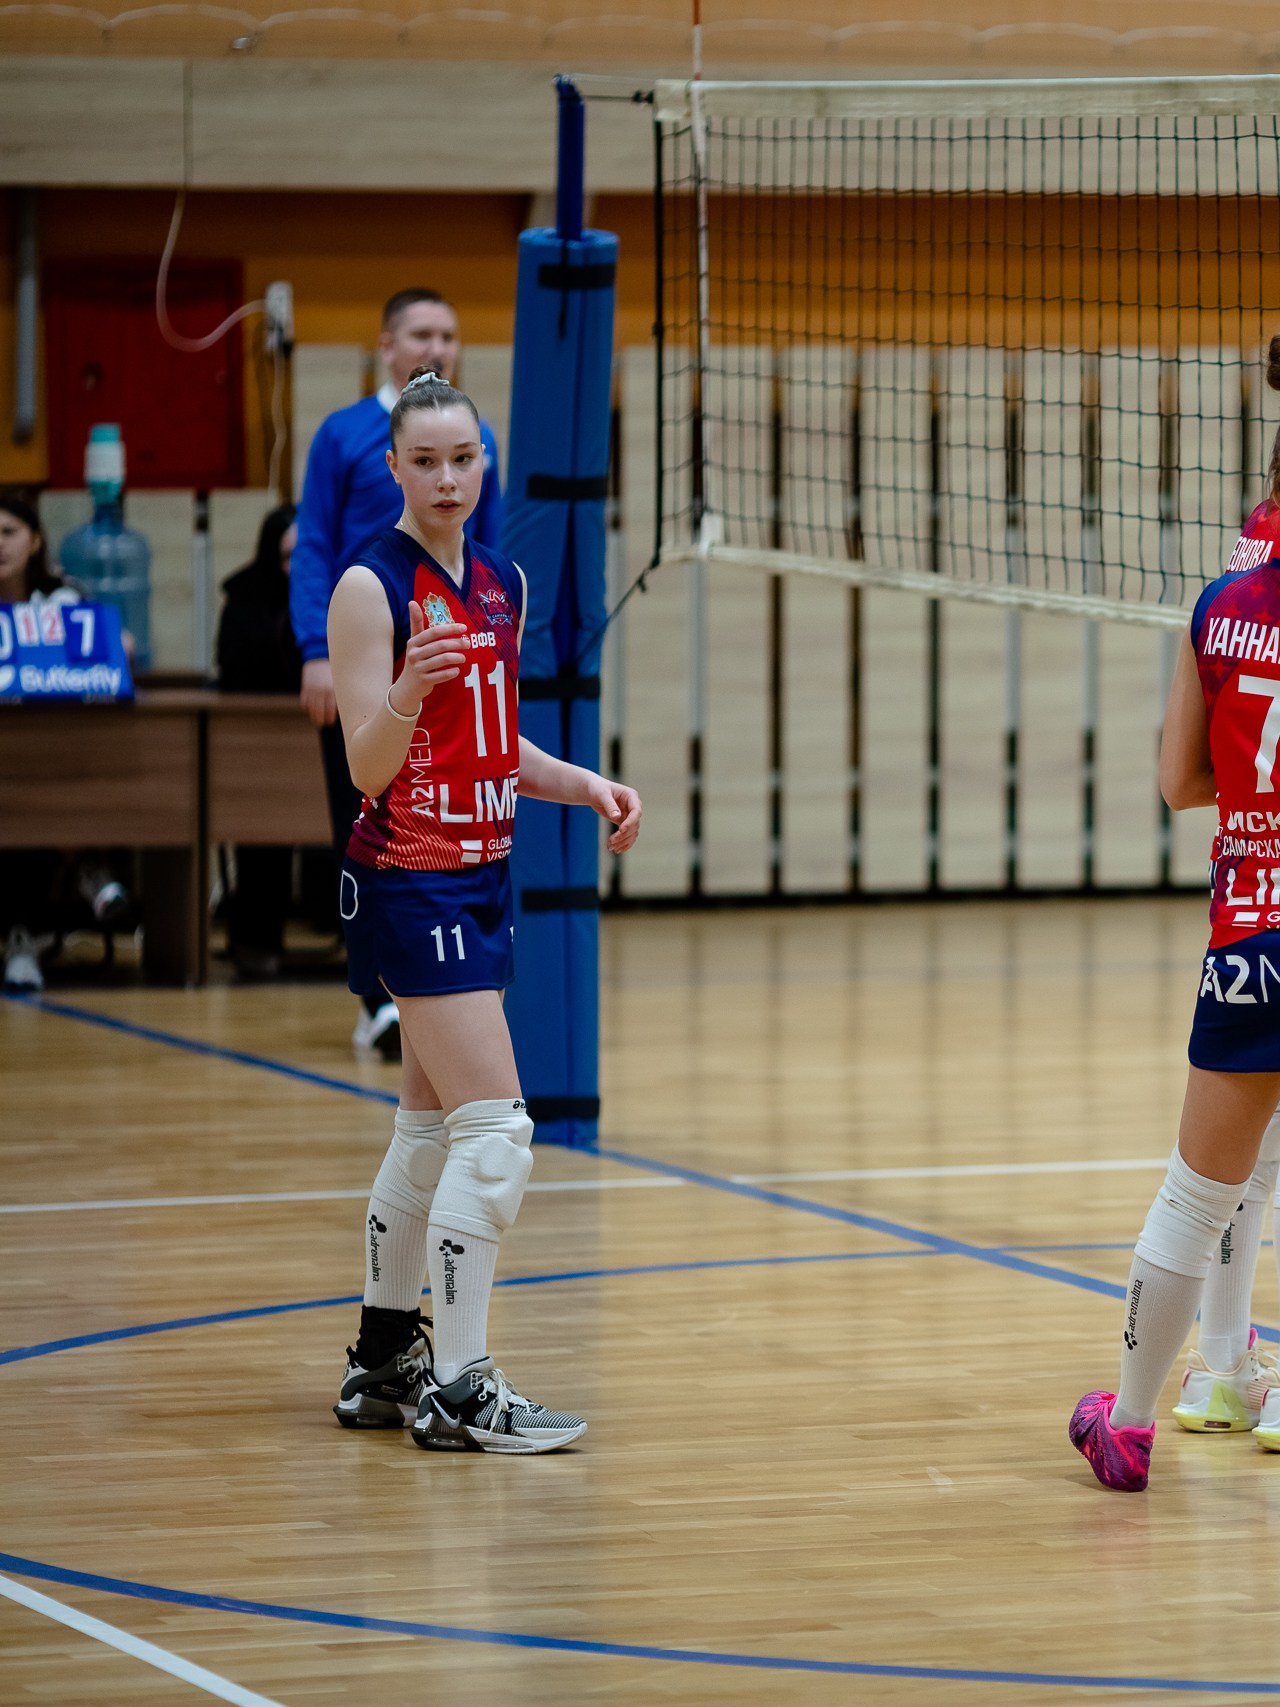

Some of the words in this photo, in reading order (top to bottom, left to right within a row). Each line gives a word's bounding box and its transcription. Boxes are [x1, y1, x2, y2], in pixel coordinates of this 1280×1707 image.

[70, 608, 95, 657] 7
[470, 631, 497, 649] ВФВ
[464, 660, 508, 757] 11
[408, 727, 435, 818] A2MED
[487, 834, 513, 851] GLOBA
[430, 924, 466, 962] 11
